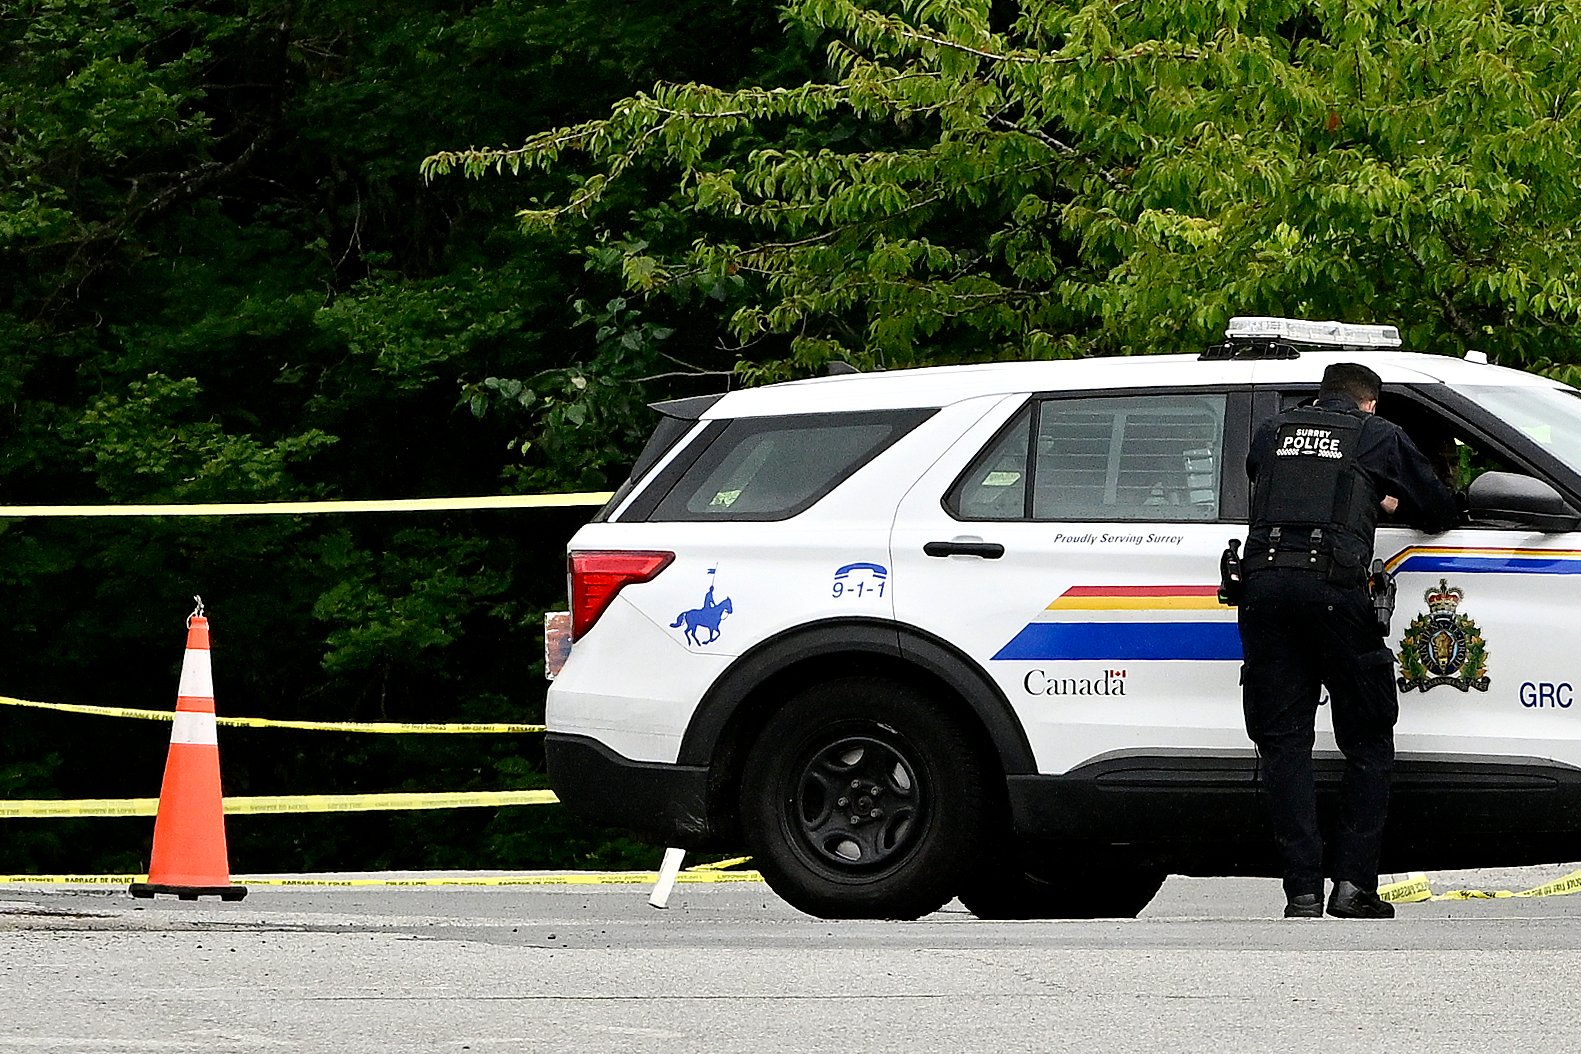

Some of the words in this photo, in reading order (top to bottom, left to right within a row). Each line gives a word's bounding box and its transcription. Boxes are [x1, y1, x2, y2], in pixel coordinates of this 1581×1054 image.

[1296, 428, 1331, 438] SURREY
[1283, 436, 1340, 450] POLICE
[1054, 533, 1097, 545] Proudly
[1100, 533, 1143, 545] Serving
[1146, 533, 1184, 545] Surrey
[832, 581, 886, 598] 9-1-1
[1023, 668, 1127, 696] Canada
[1519, 681, 1573, 709] GRC
